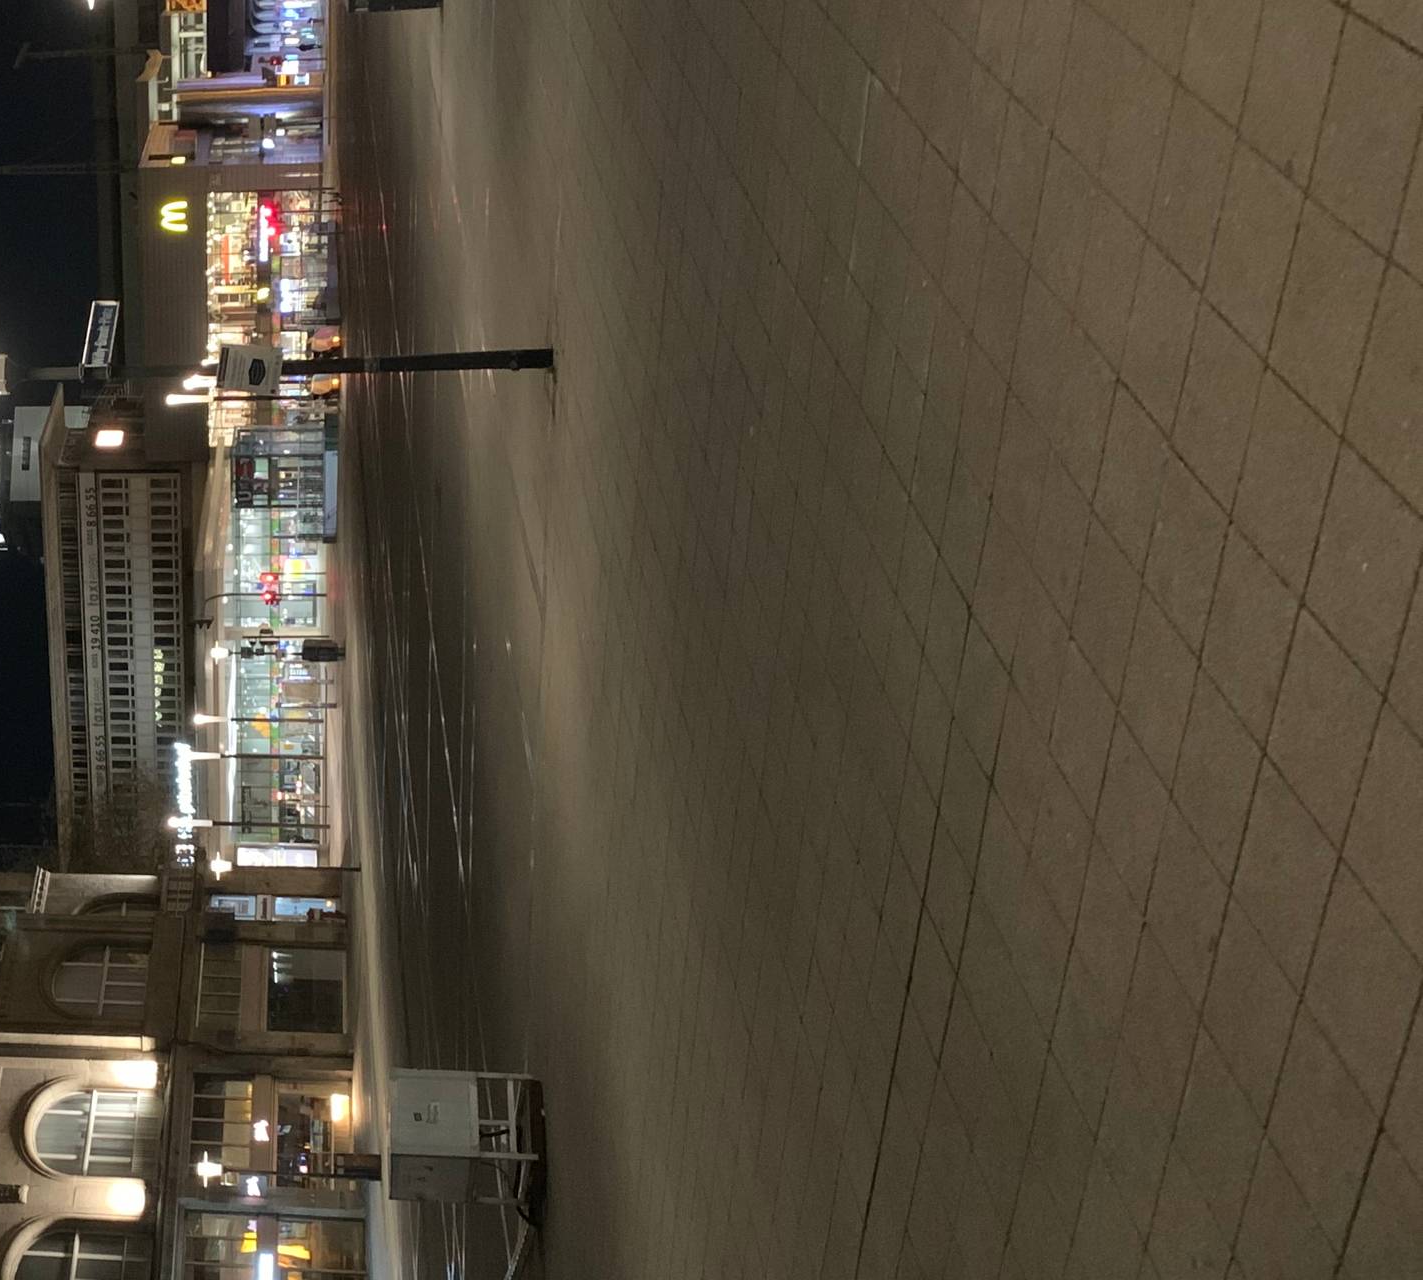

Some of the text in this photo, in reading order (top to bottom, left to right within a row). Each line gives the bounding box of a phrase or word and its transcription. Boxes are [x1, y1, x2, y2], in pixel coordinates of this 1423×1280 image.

[85, 487, 95, 500] 55
[85, 503, 96, 517] 66
[89, 615, 100, 634] 410
[91, 637, 101, 649] 19
[94, 735, 105, 746] 55
[95, 750, 105, 761] 66
